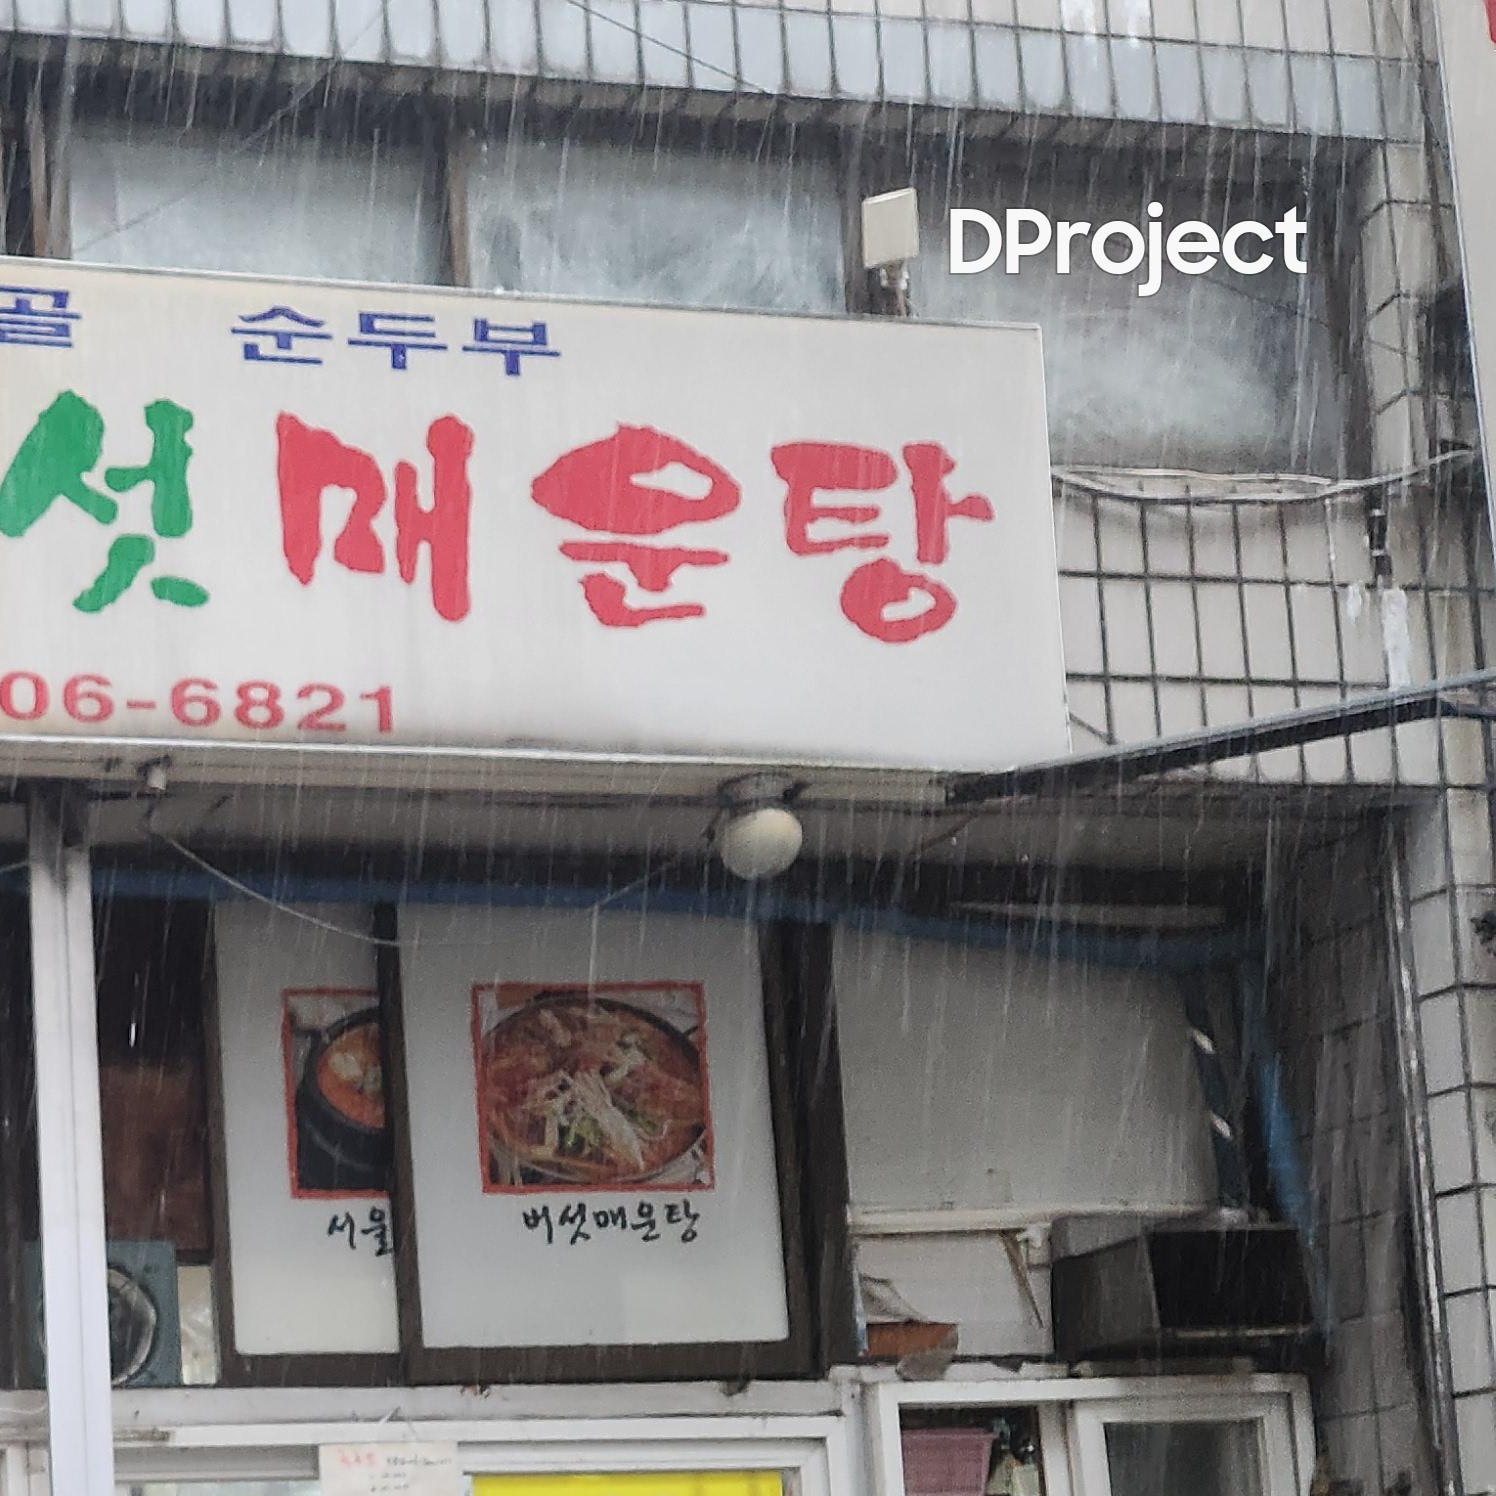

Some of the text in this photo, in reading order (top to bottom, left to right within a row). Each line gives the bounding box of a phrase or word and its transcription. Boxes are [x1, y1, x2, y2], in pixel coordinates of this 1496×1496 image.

[231, 303, 562, 378] 순두부
[275, 408, 996, 646] 매운탕
[521, 1198, 703, 1243] 버섯매운탕
